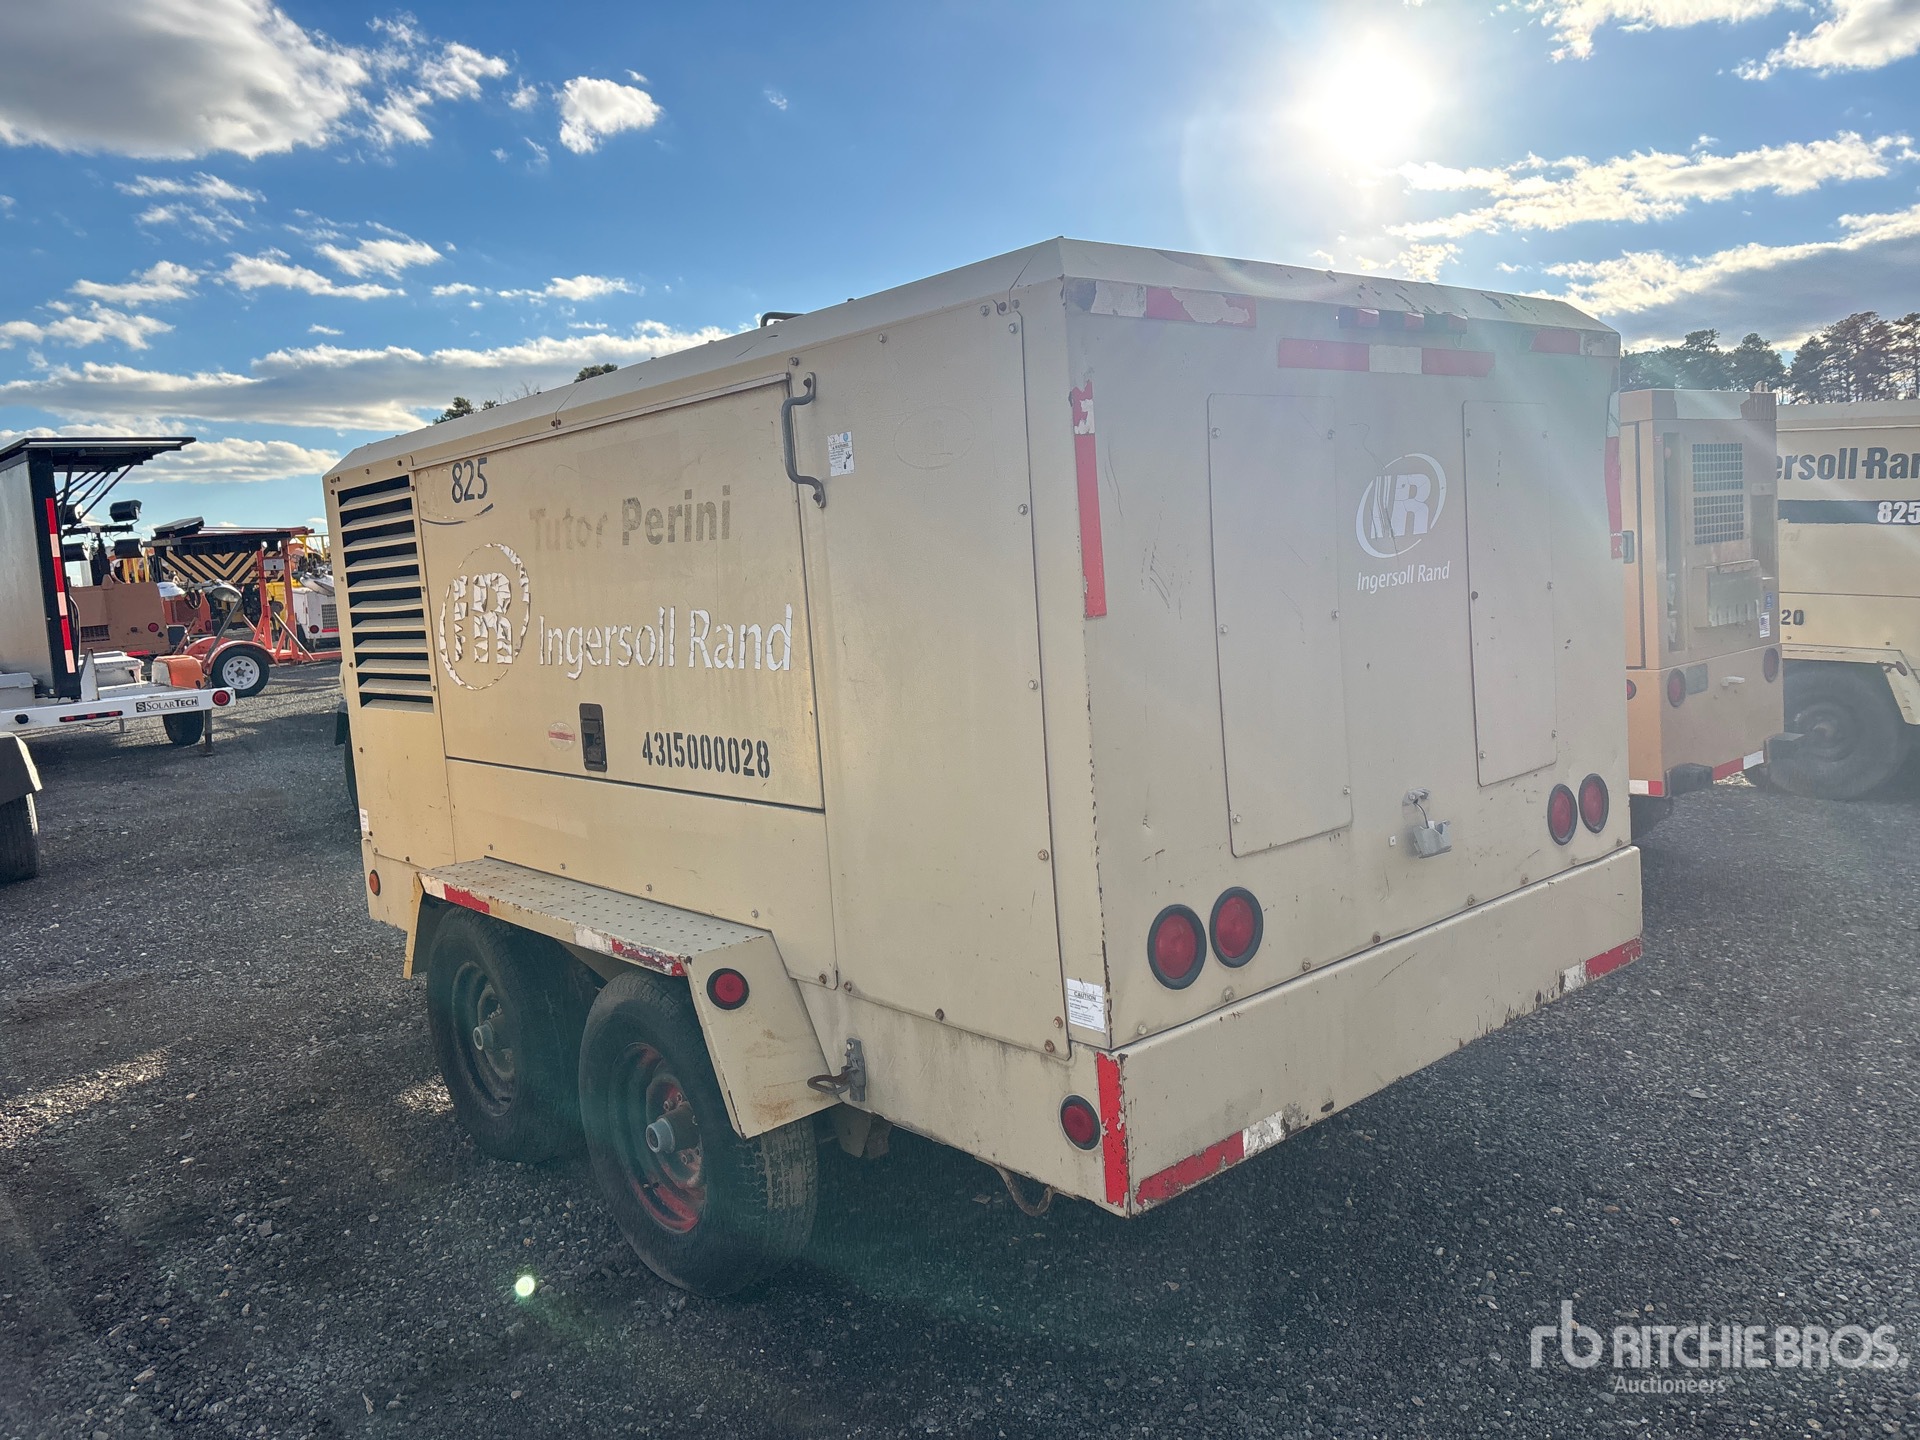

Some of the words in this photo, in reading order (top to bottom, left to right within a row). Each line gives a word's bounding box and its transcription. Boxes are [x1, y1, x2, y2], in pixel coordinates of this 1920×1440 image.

[452, 457, 488, 503] 825
[622, 484, 730, 545] Perini
[1877, 501, 1920, 524] 825
[1357, 564, 1414, 594] Ingersoll
[1417, 560, 1450, 582] Rand
[539, 605, 676, 681] Ingersoll
[688, 603, 793, 672] Rand
[642, 731, 771, 779] 4315000028
[1073, 991, 1097, 1002] CAUTION
